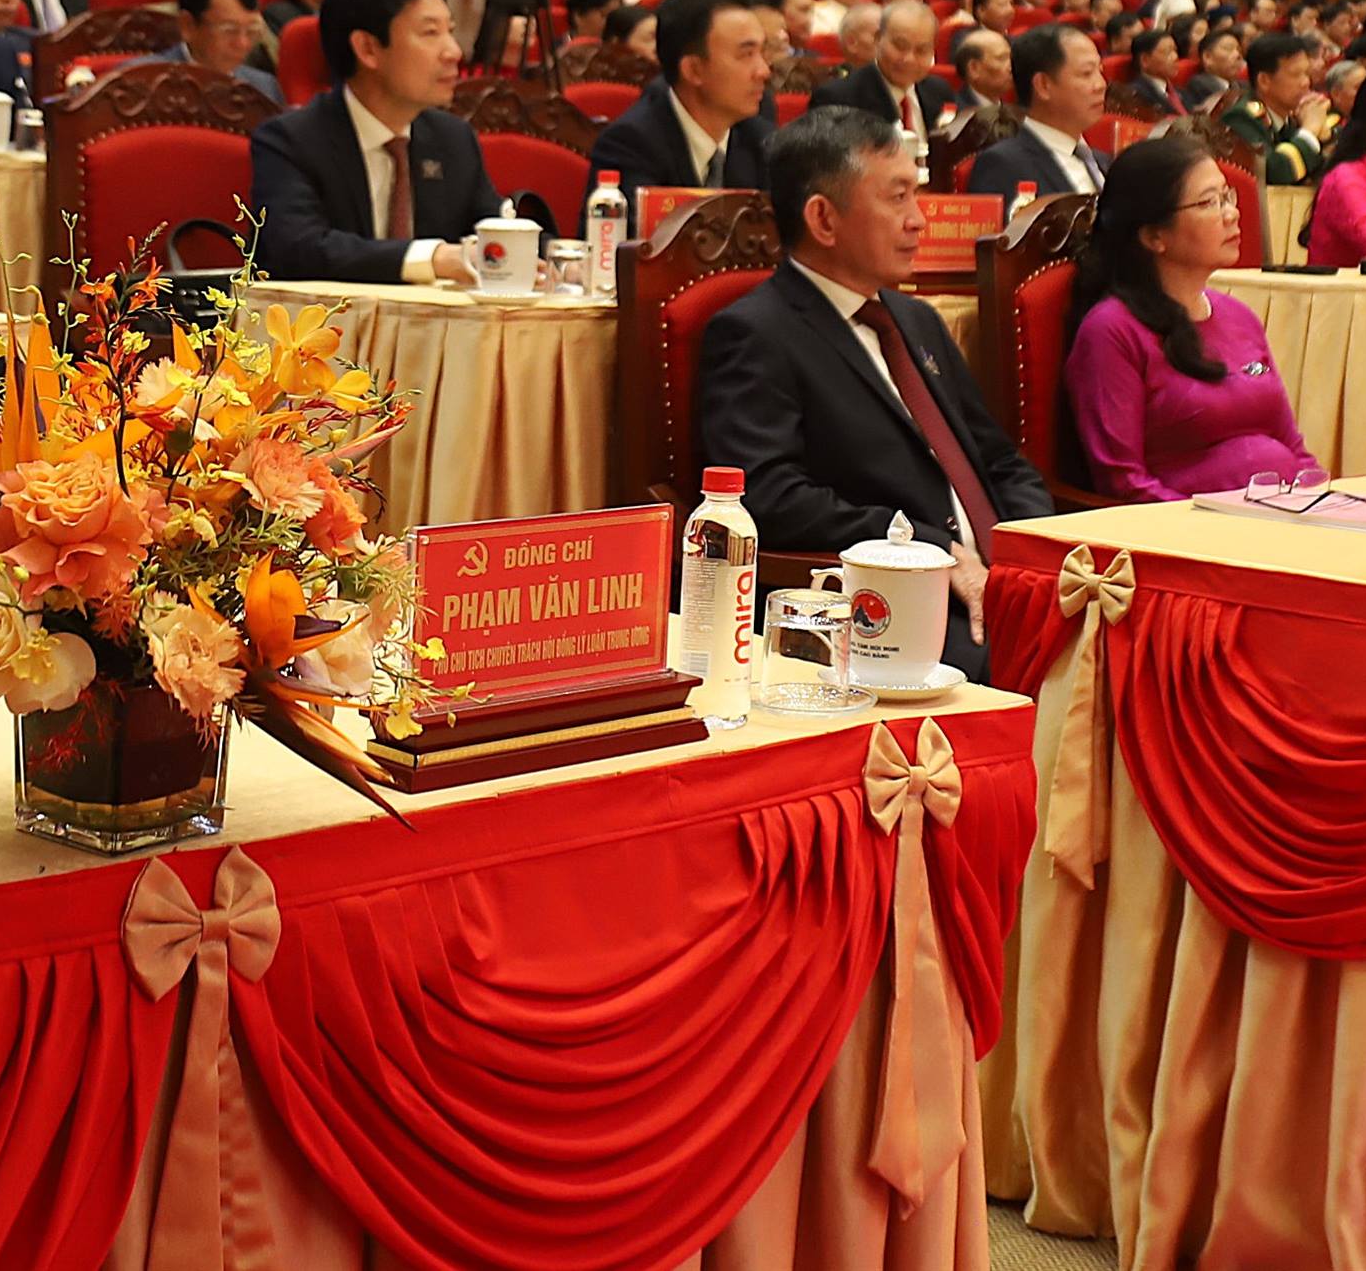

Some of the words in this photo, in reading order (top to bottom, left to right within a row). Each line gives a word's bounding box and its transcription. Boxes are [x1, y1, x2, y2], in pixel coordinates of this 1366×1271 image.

[504, 538, 557, 570] ĐỒNG
[562, 534, 595, 563] CHÍ
[442, 586, 522, 636] PHẠM
[529, 573, 580, 622] VĂN
[587, 572, 644, 614] LINH
[734, 571, 753, 665] mira
